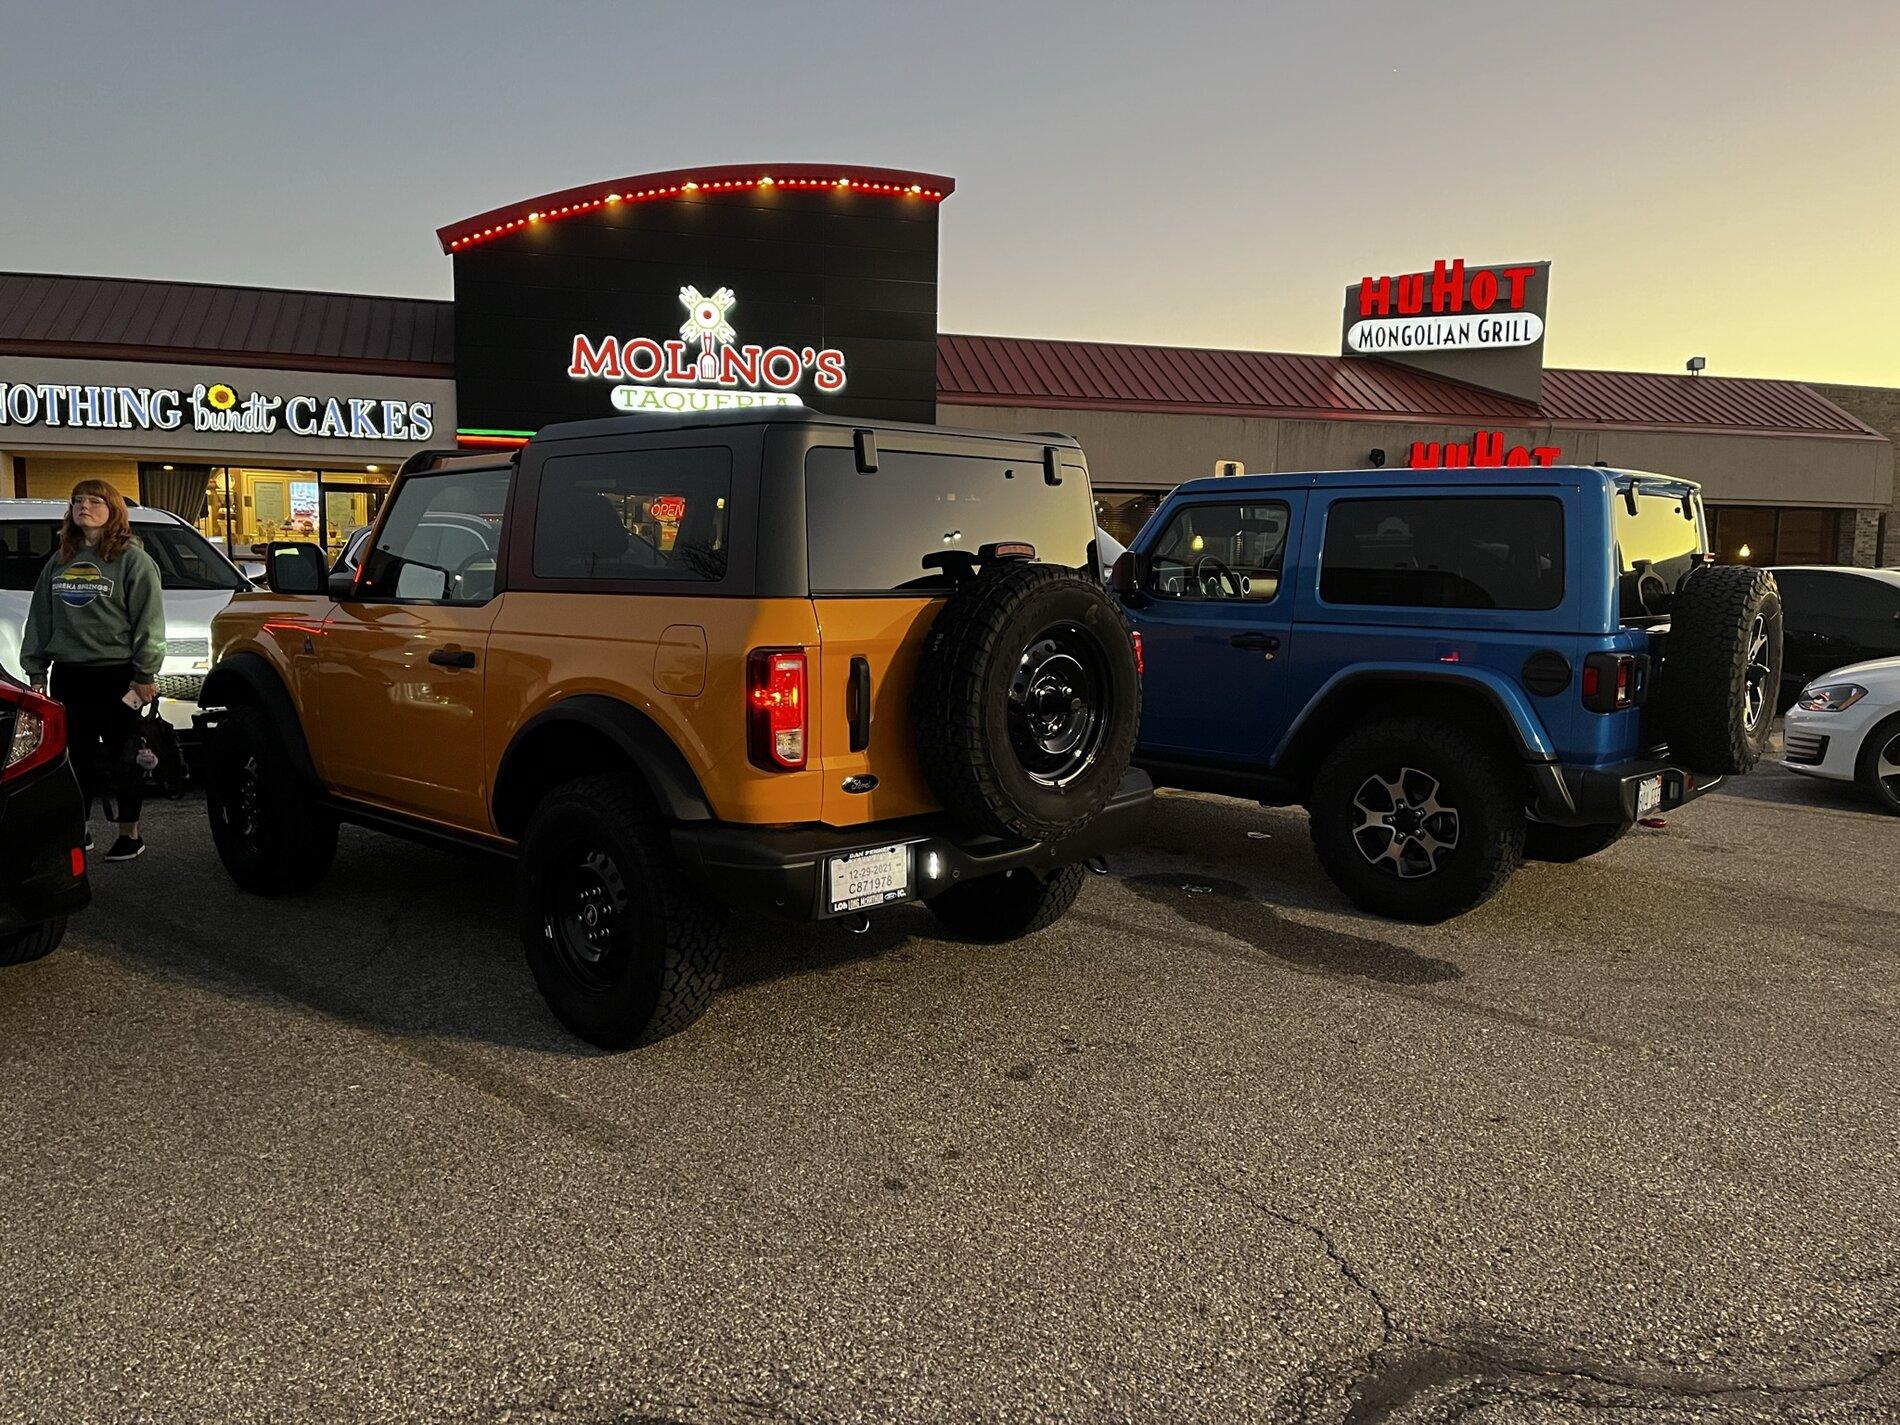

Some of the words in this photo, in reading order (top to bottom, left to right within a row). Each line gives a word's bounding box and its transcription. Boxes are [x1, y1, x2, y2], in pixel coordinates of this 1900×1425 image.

[1358, 322, 1471, 349] MONGOLIAN
[1477, 318, 1532, 343] GRILL
[188, 383, 282, 434] bundt
[286, 396, 434, 440] CAKES
[650, 504, 685, 516] OPEN
[850, 864, 891, 878] 12-29-2021
[849, 876, 892, 894] C871978
